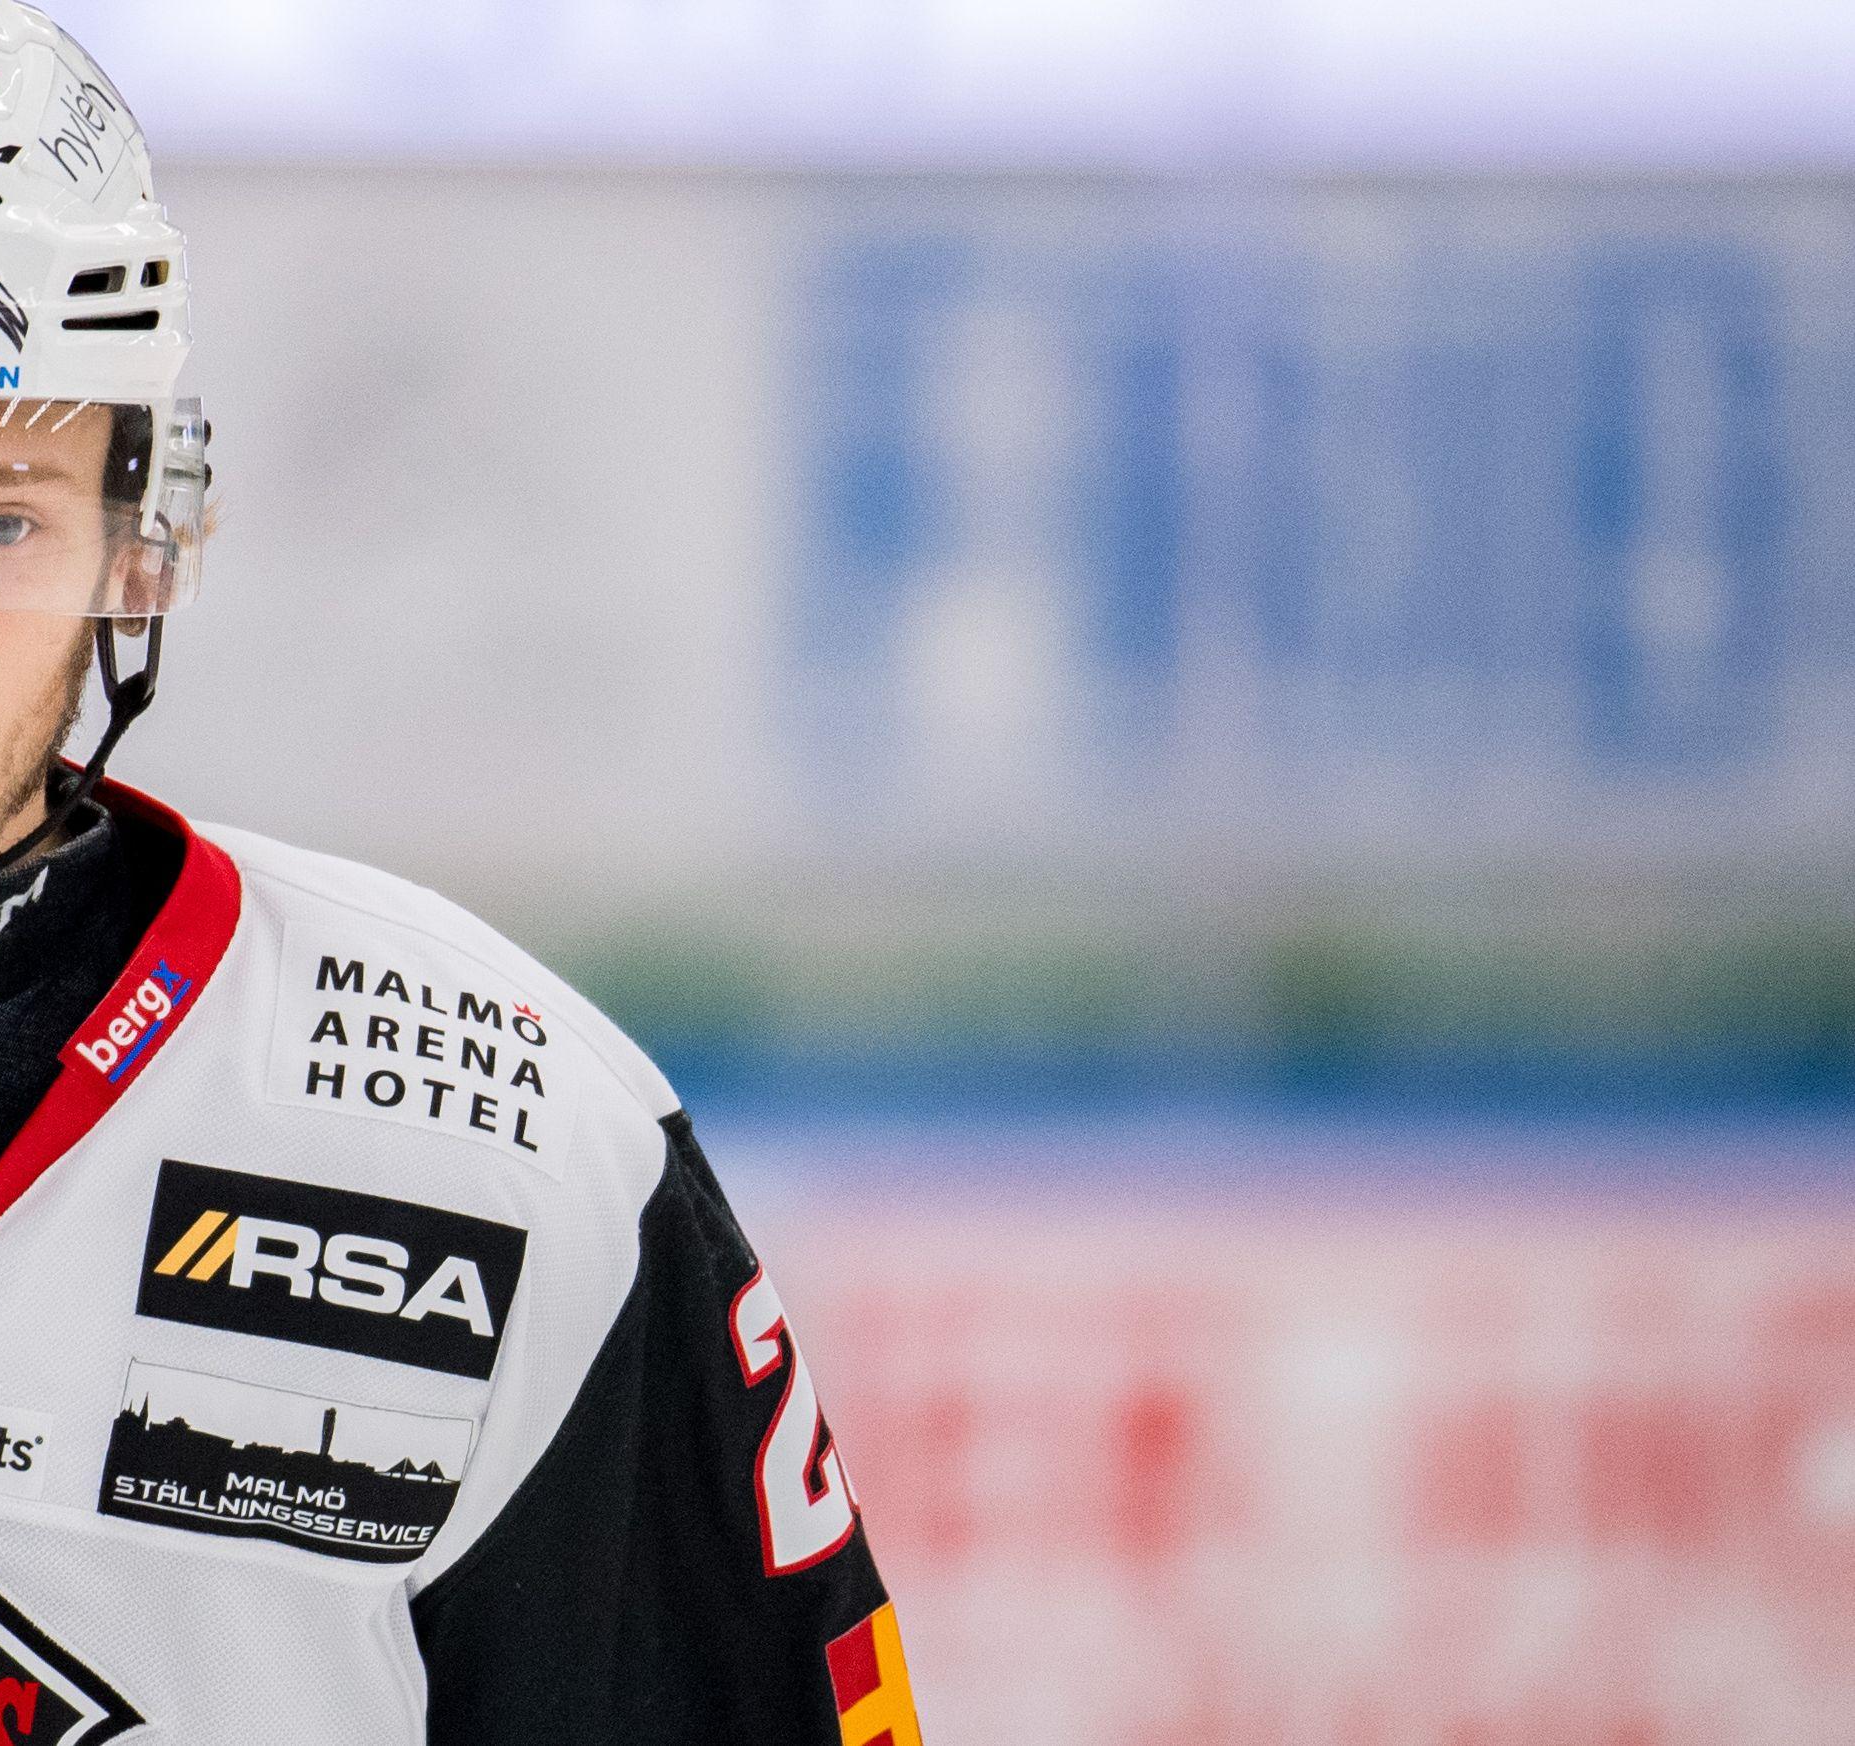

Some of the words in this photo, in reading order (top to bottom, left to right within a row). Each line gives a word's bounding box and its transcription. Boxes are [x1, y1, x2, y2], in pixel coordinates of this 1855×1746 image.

[38, 81, 116, 183] hylén
[309, 1011, 546, 1098] ARENA
[305, 1060, 539, 1153] HOTEL
[229, 1215, 495, 1337] RSA
[729, 1258, 861, 1578] 2
[114, 1475, 435, 1544] STÄLLNINGSSERVICE
[226, 1472, 346, 1511] MALMÖ
